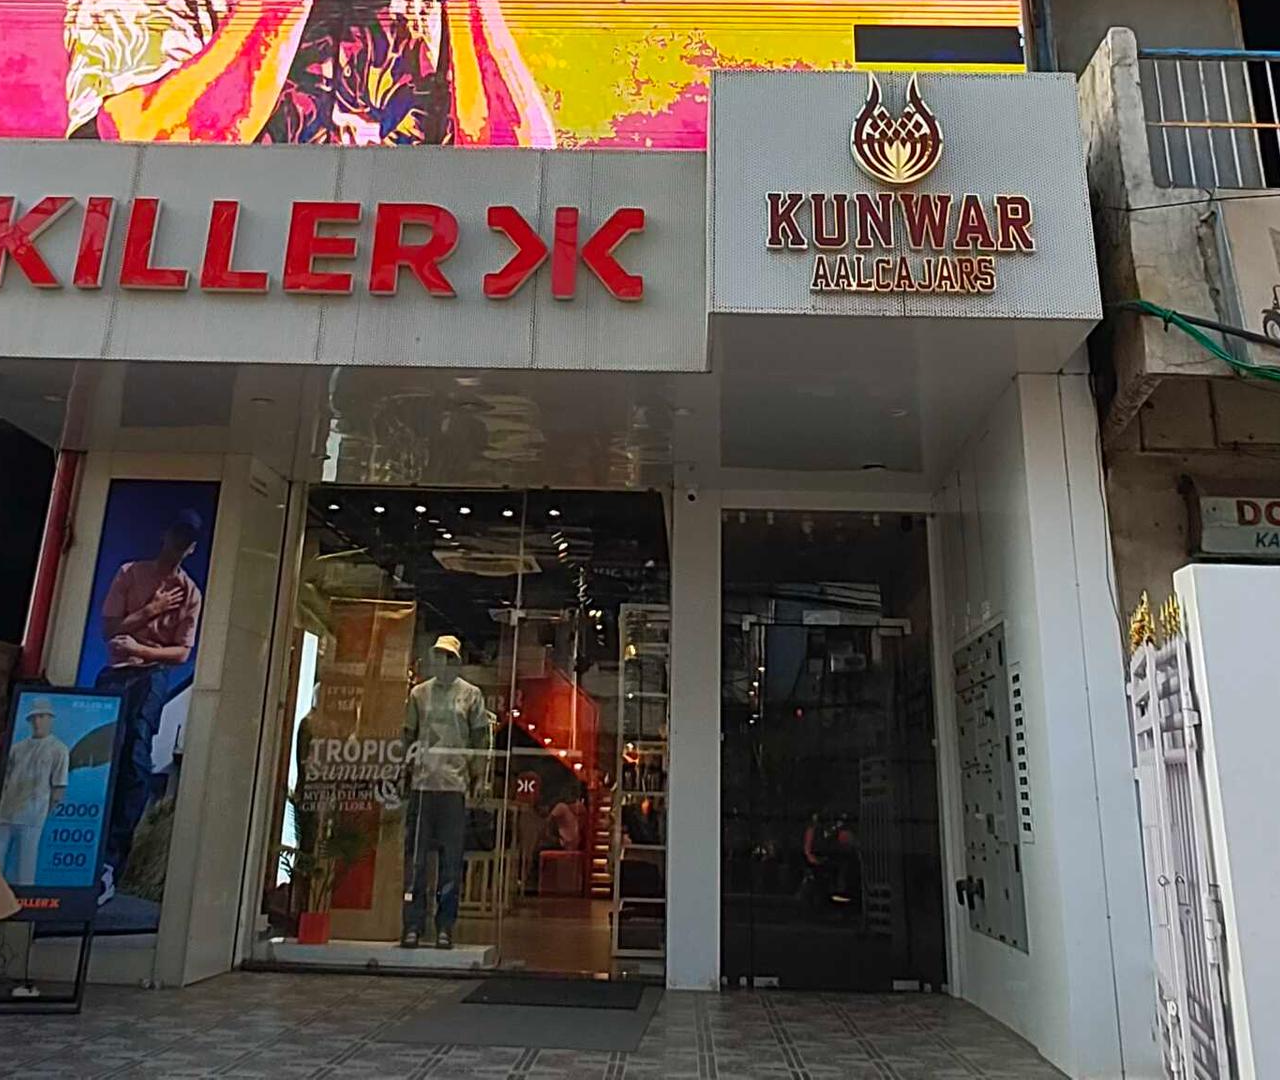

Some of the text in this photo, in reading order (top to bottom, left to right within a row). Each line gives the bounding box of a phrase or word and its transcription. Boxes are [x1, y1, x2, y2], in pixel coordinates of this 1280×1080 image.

[766, 192, 1036, 252] KUNWAR
[810, 255, 997, 293] AALCAJARS
[303, 738, 423, 765] TROPICA
[305, 761, 403, 782] Summer
